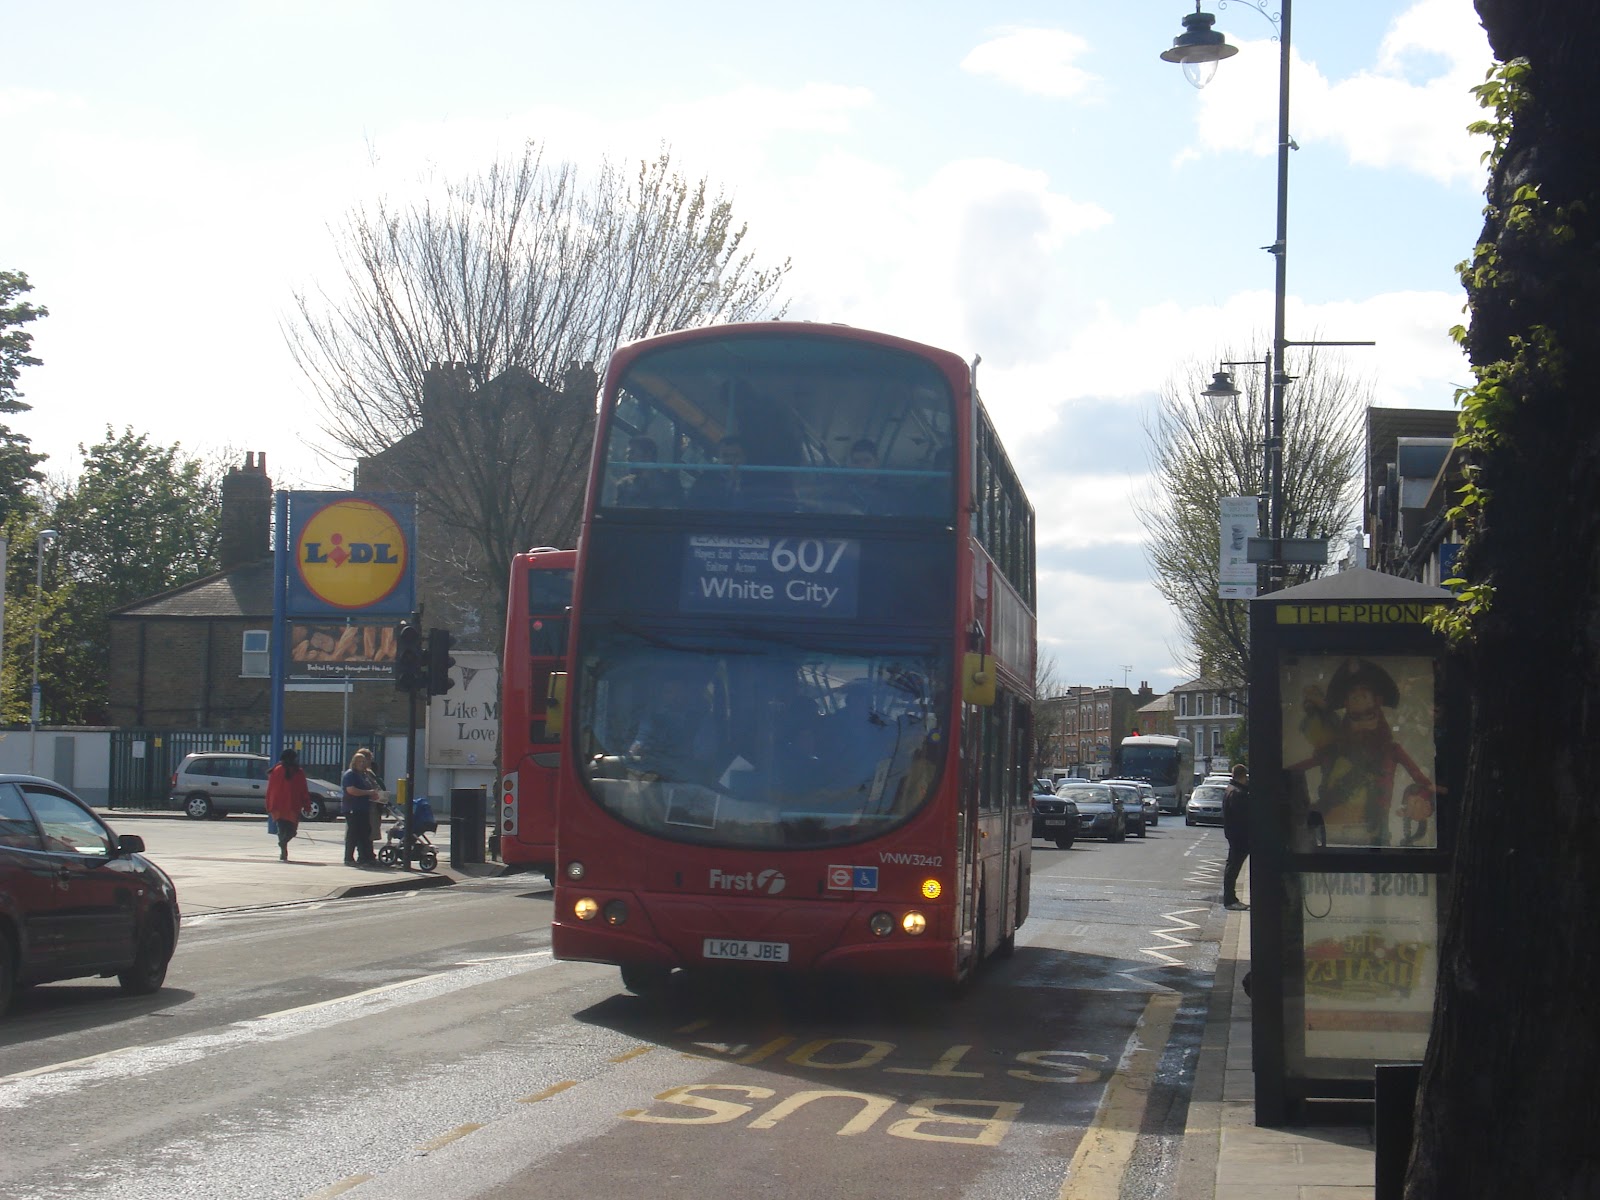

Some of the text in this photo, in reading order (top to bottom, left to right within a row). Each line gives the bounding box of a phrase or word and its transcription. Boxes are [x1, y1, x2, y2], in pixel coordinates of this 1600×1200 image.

[304, 533, 398, 568] LIDL
[771, 537, 849, 573] 607
[700, 577, 839, 608] White City
[1291, 604, 1433, 624] TELEPHONE
[443, 699, 498, 721] Like M
[457, 722, 495, 742] Love
[879, 851, 943, 867] VNW32412
[709, 869, 753, 891] First
[709, 941, 783, 960] LK04 JBE
[616, 1083, 1025, 1147] BUS
